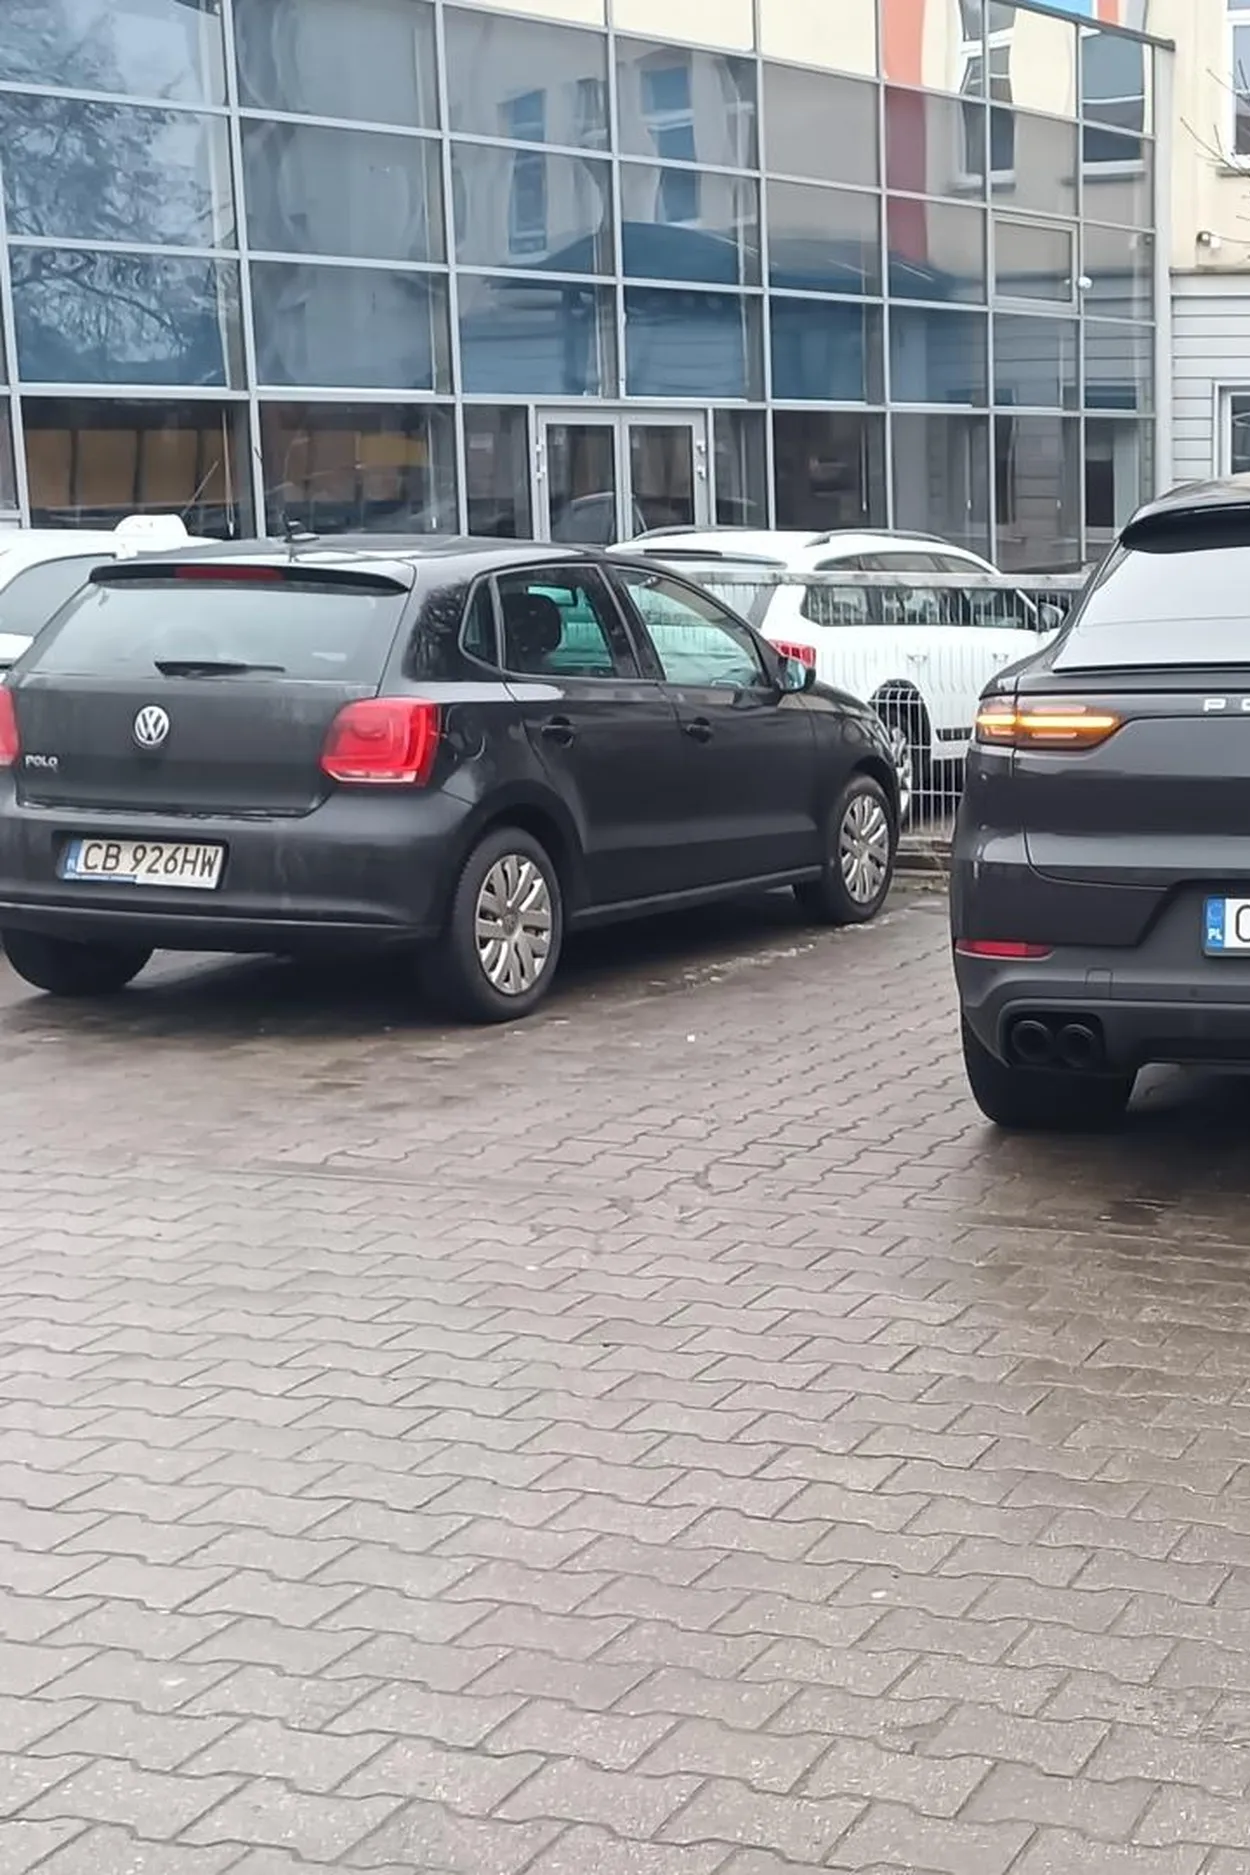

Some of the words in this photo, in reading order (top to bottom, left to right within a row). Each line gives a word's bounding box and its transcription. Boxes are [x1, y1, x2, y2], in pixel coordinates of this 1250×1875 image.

[25, 755, 59, 768] POLO
[84, 843, 121, 871] CB
[129, 845, 218, 877] 926HW
